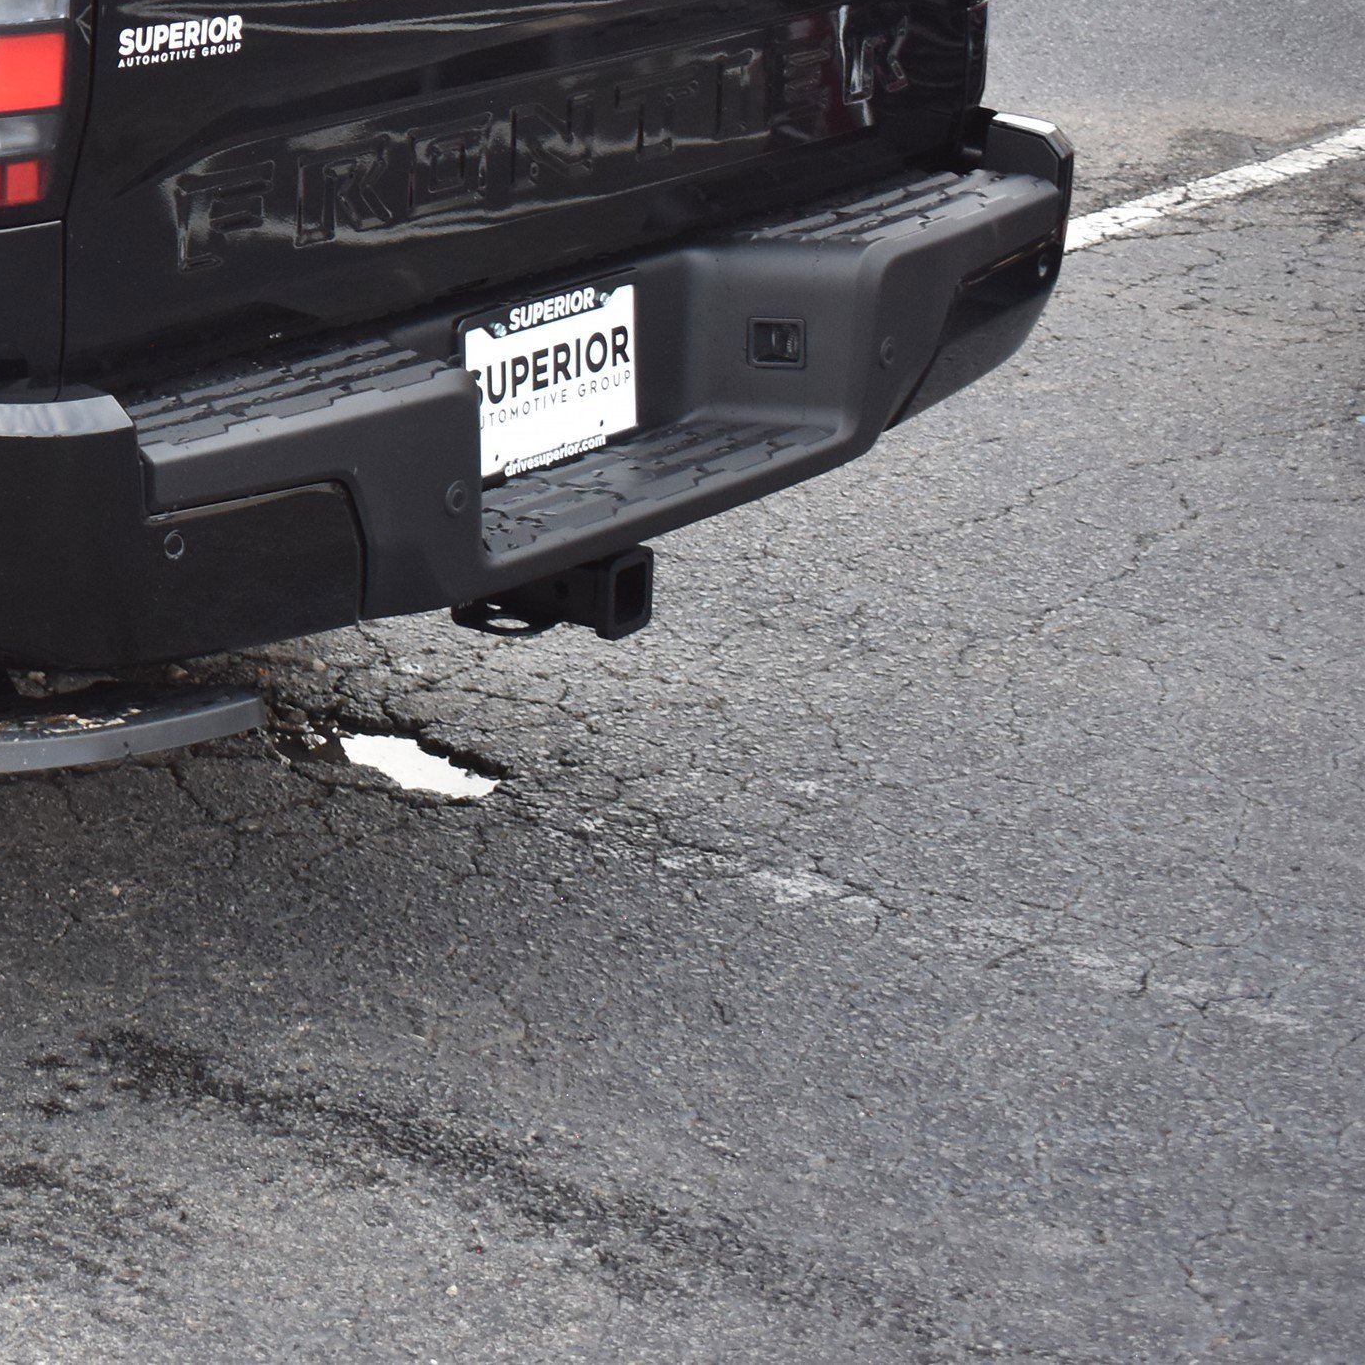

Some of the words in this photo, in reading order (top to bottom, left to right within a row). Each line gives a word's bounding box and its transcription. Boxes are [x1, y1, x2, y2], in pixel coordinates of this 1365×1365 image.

[117, 48, 196, 68] AUTOMOTIVE
[201, 42, 242, 57] GROUP
[118, 14, 244, 56] SUPERIOR
[508, 287, 595, 331] SUPERIOR
[479, 388, 568, 431] UTOMOTIVE
[578, 369, 632, 398] GROUP
[504, 434, 607, 478] drivesuperior.com
